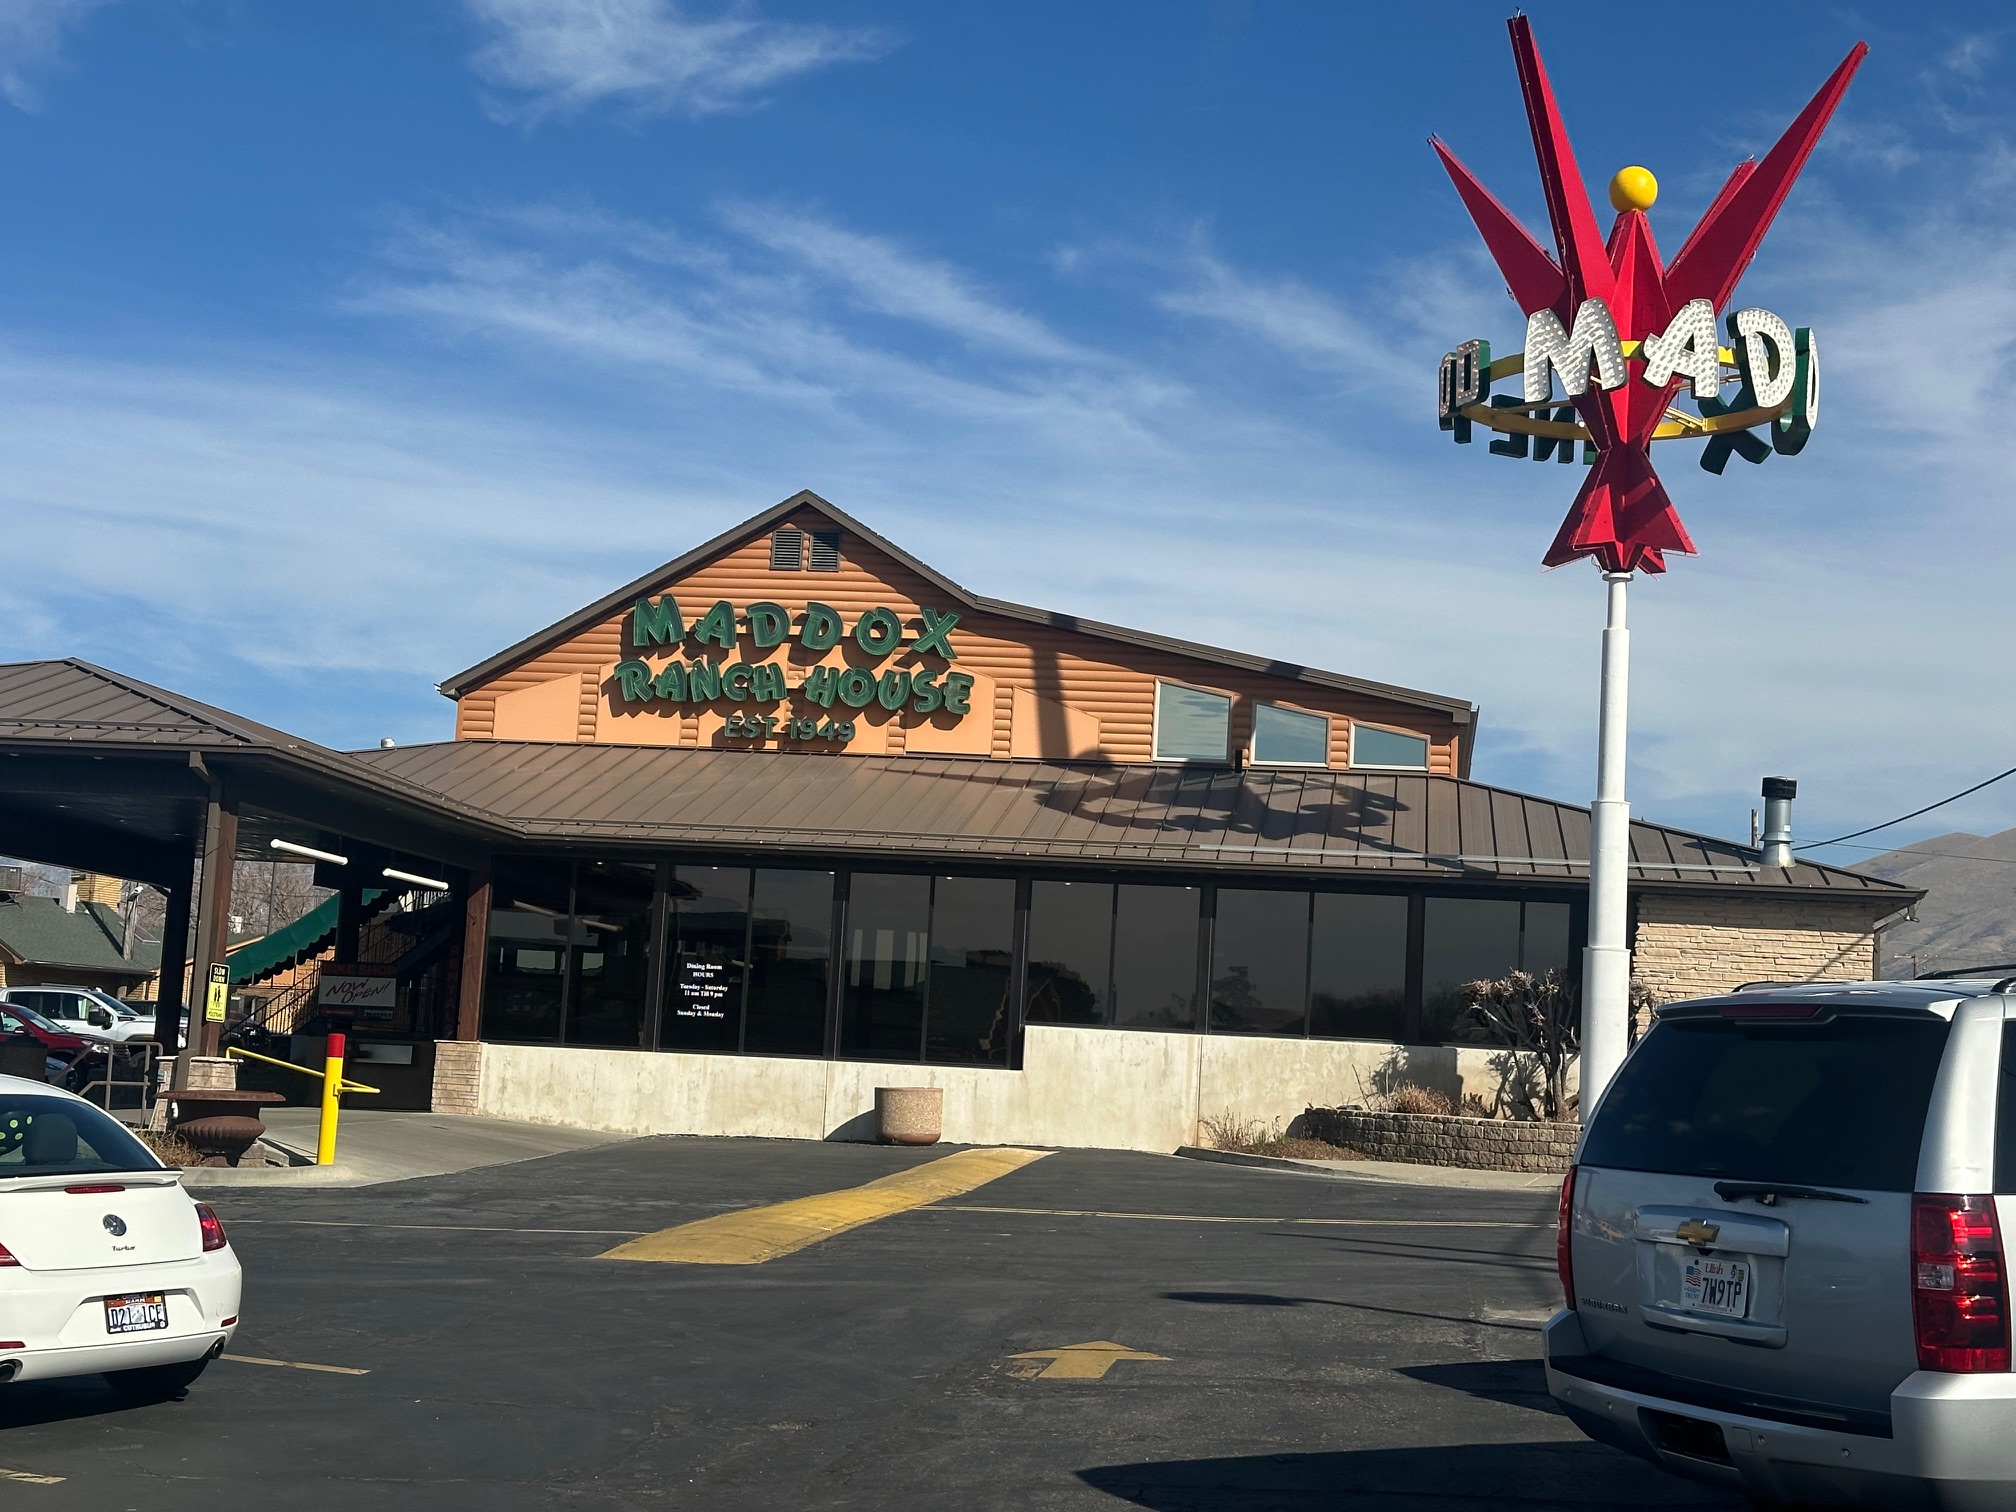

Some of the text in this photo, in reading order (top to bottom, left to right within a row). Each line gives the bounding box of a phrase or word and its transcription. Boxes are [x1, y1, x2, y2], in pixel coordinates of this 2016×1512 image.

[633, 593, 962, 660] MADDOX
[614, 659, 975, 715] RANCH HOUSE
[724, 715, 857, 742] EST 1949
[325, 978, 370, 998] NOW
[341, 980, 392, 1004] OPEN!
[680, 983, 701, 991] Tuesday
[704, 984, 728, 992] Saturday
[1705, 1262, 1724, 1275] Utah
